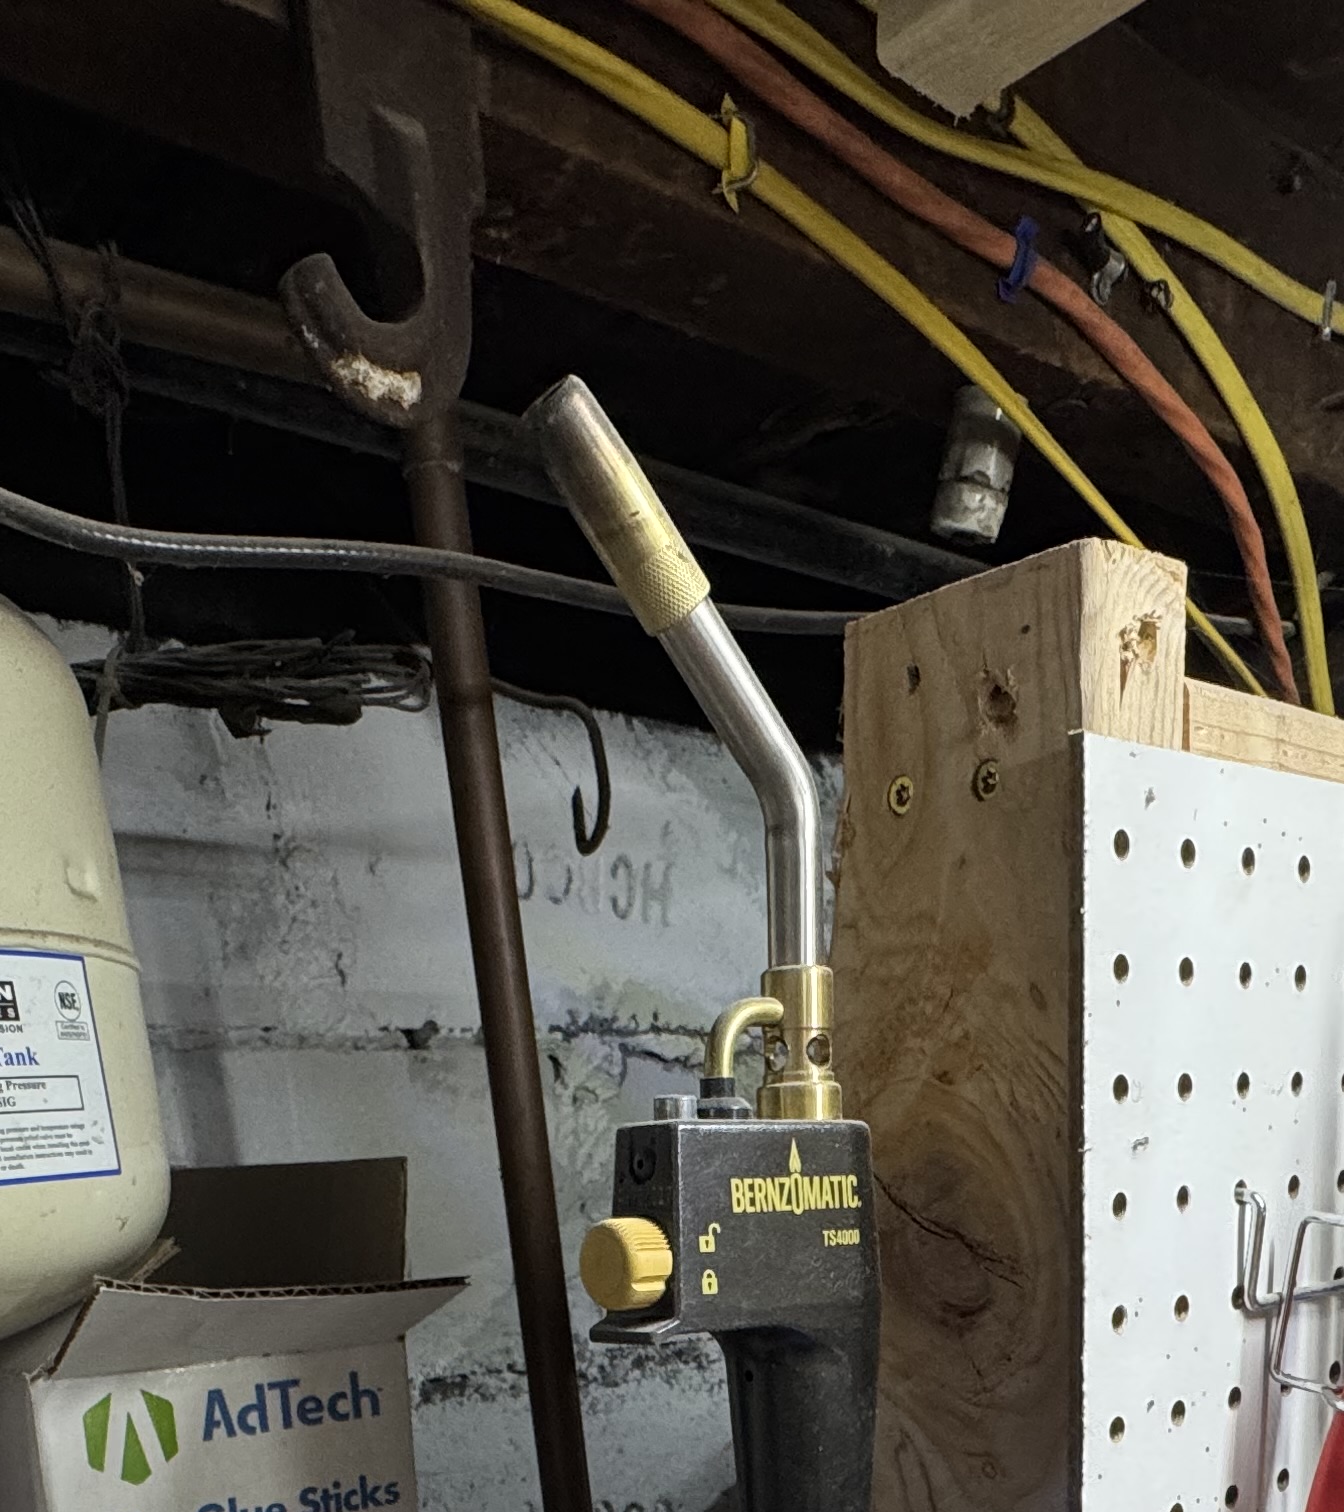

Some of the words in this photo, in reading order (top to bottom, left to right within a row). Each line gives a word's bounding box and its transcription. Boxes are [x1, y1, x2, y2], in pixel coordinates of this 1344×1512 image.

[6, 1080, 47, 1090] Pressure
[730, 1172, 858, 1215] BERNZOMATIC
[822, 1229, 861, 1247] TS4000
[201, 1371, 381, 1441] AdTech
